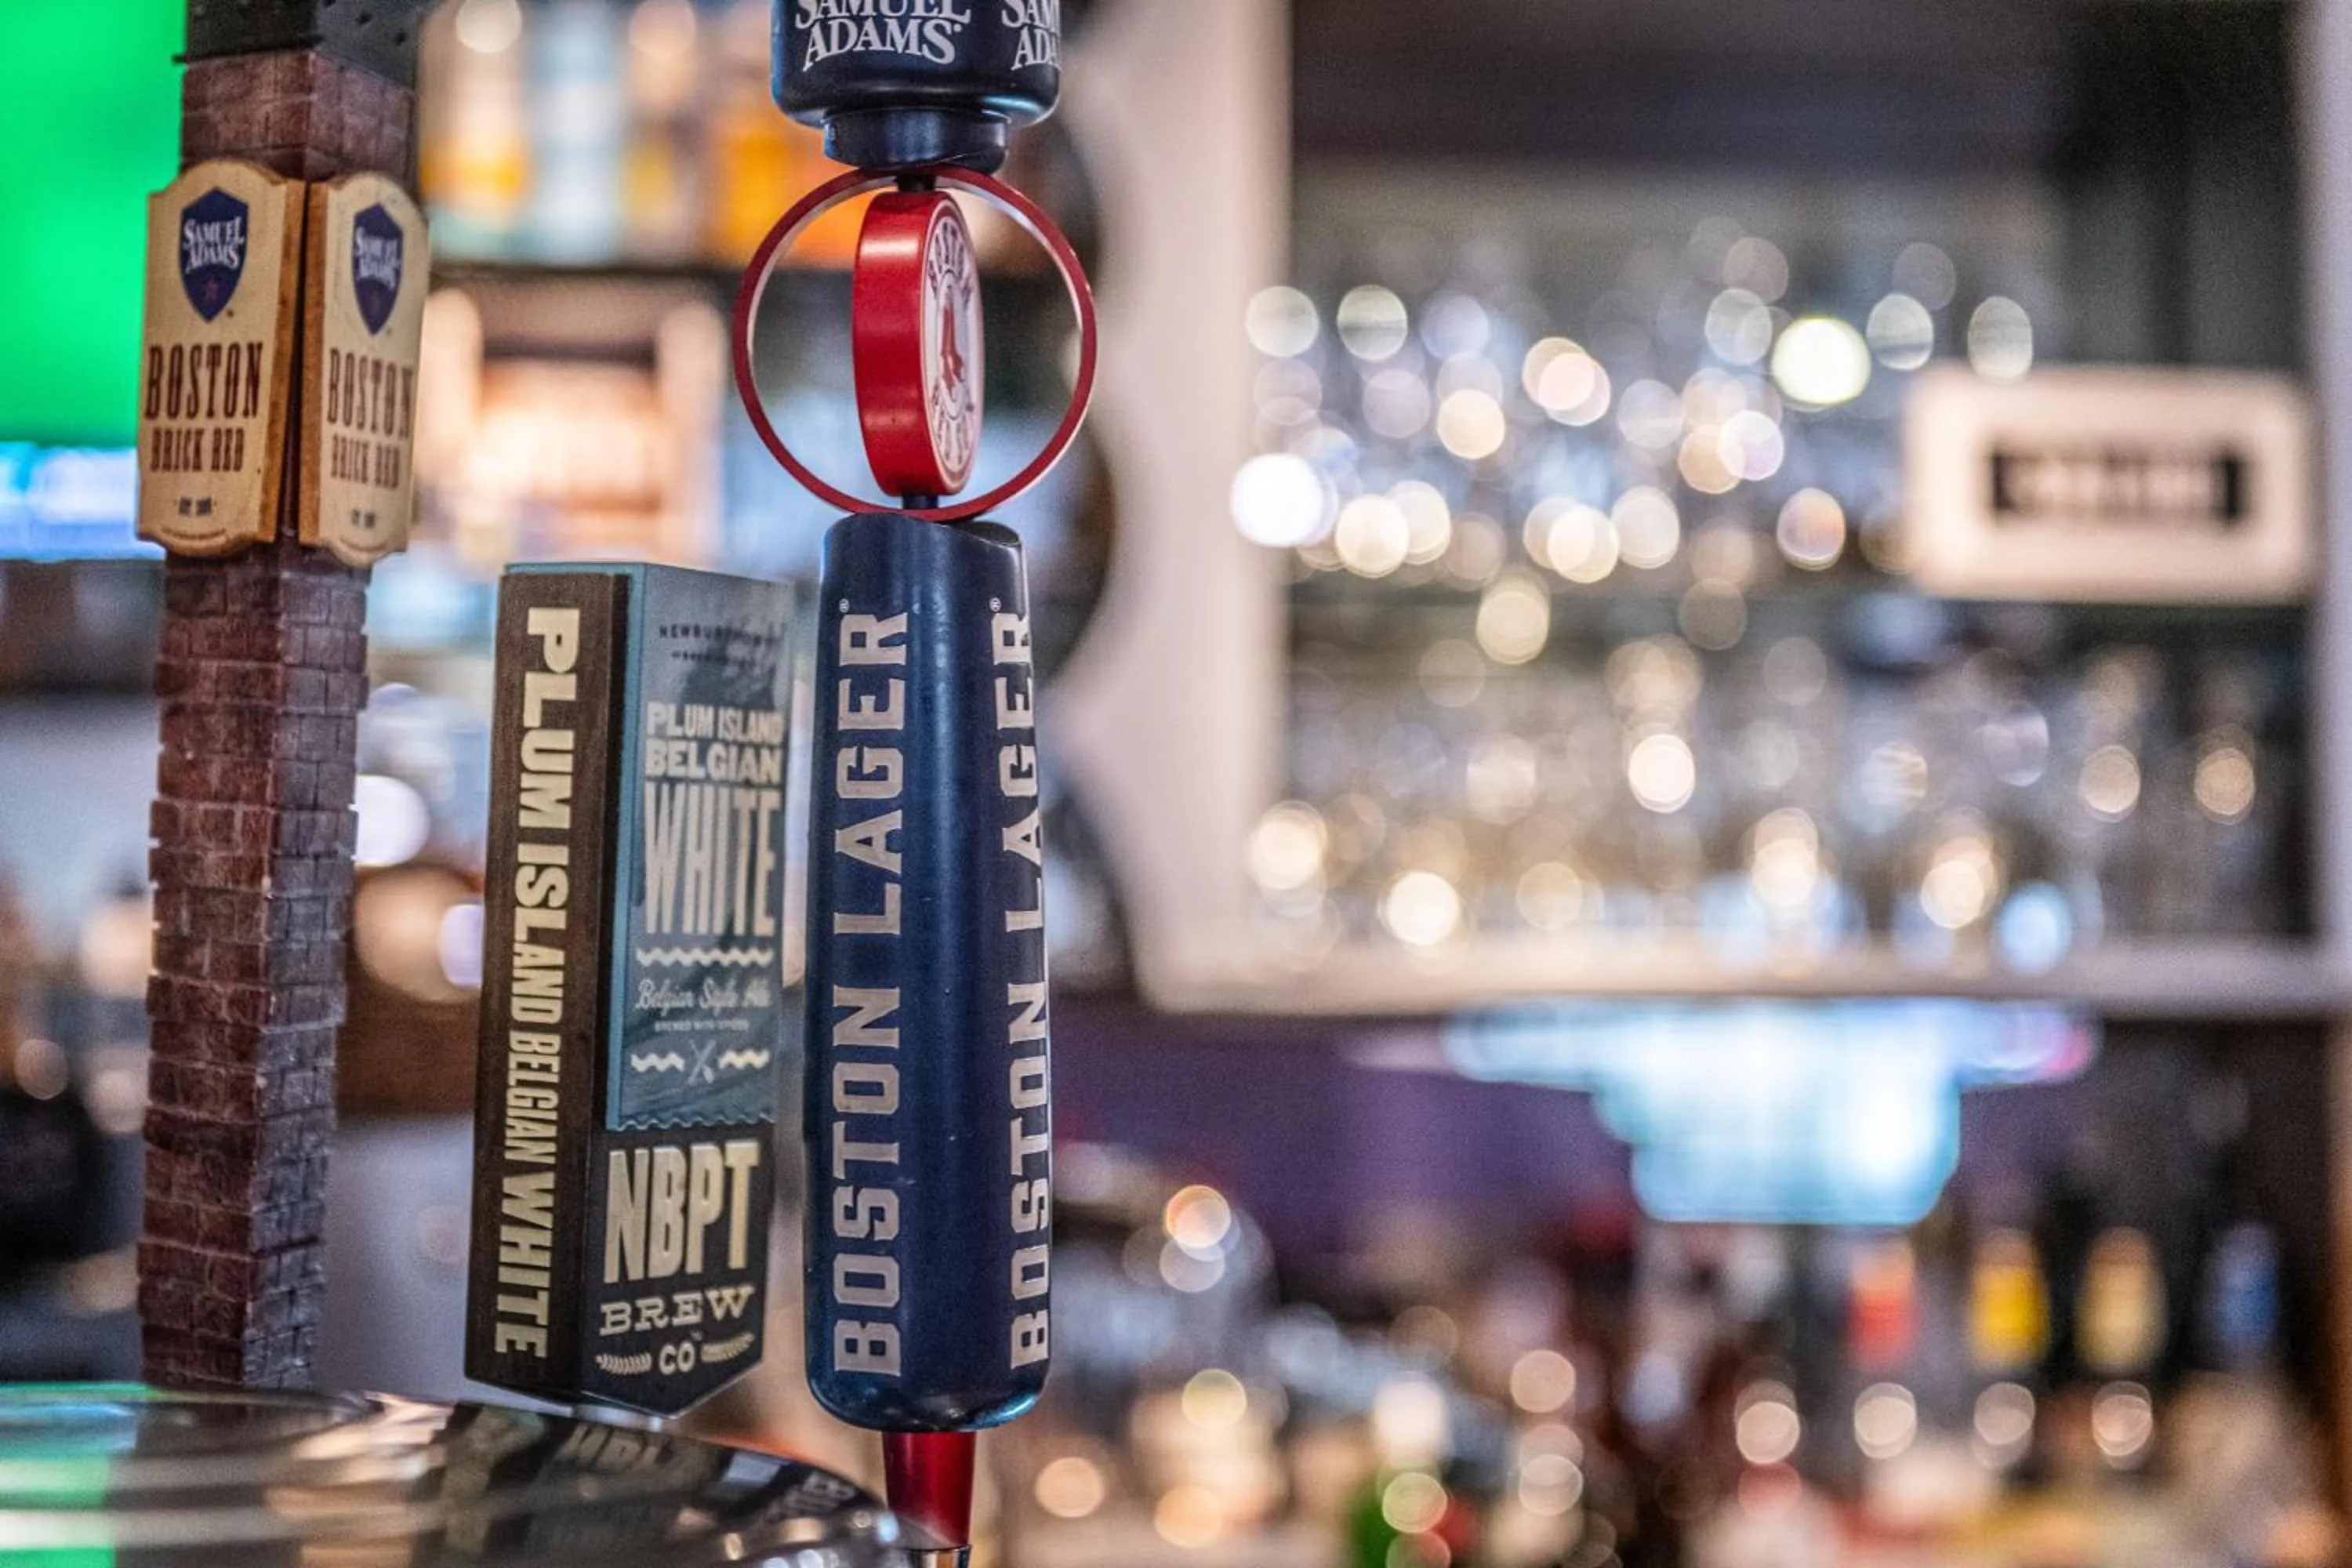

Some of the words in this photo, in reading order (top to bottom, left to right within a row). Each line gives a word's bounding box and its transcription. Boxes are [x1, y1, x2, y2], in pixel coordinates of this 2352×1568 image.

[803, 18, 956, 72] ADAMS
[183, 217, 244, 249] SAMUEL
[186, 241, 240, 274] ADAMS
[145, 342, 263, 420] BOSTON
[327, 347, 413, 439] BOSTON
[151, 428, 204, 474] BRICK
[210, 427, 245, 472] RED
[519, 608, 580, 829] PLUM
[644, 740, 782, 782] BELGIAN
[647, 702, 714, 738] PLUM
[717, 708, 783, 746] ISLAND
[833, 611, 908, 935] LAGER
[990, 612, 1044, 932] LAGER
[644, 782, 782, 936] WHITE
[511, 843, 570, 1024] ISLAND
[504, 1030, 561, 1163] BELGIAN
[604, 1139, 759, 1284] NBPT
[833, 985, 902, 1377] BOSTON
[1007, 982, 1049, 1369] BOSTON
[495, 1171, 555, 1358] WHITE
[599, 1286, 755, 1335] BREW
[658, 1342, 695, 1375] CO
